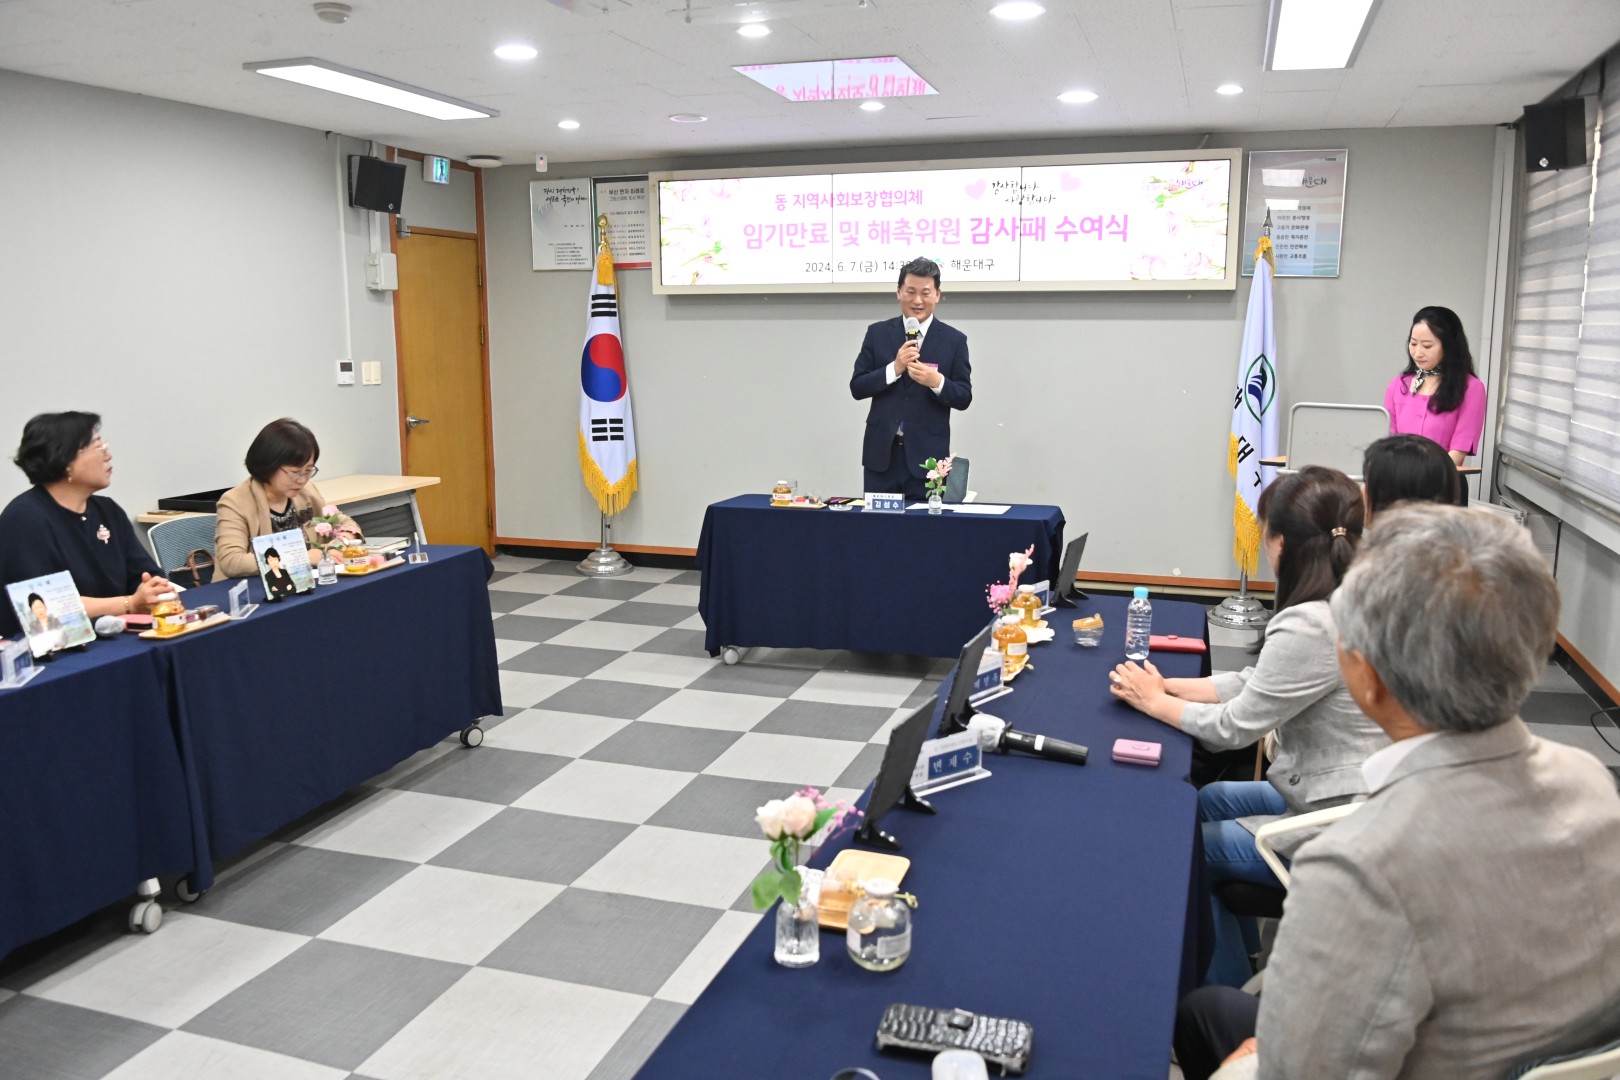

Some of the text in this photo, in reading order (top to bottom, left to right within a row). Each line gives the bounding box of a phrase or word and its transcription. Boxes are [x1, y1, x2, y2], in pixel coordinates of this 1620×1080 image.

[775, 189, 923, 211] 동 지역사회보장협의체
[743, 214, 1129, 250] 임기만료 및 해촉위원 감사패 수여식
[951, 258, 995, 272] 해운대구
